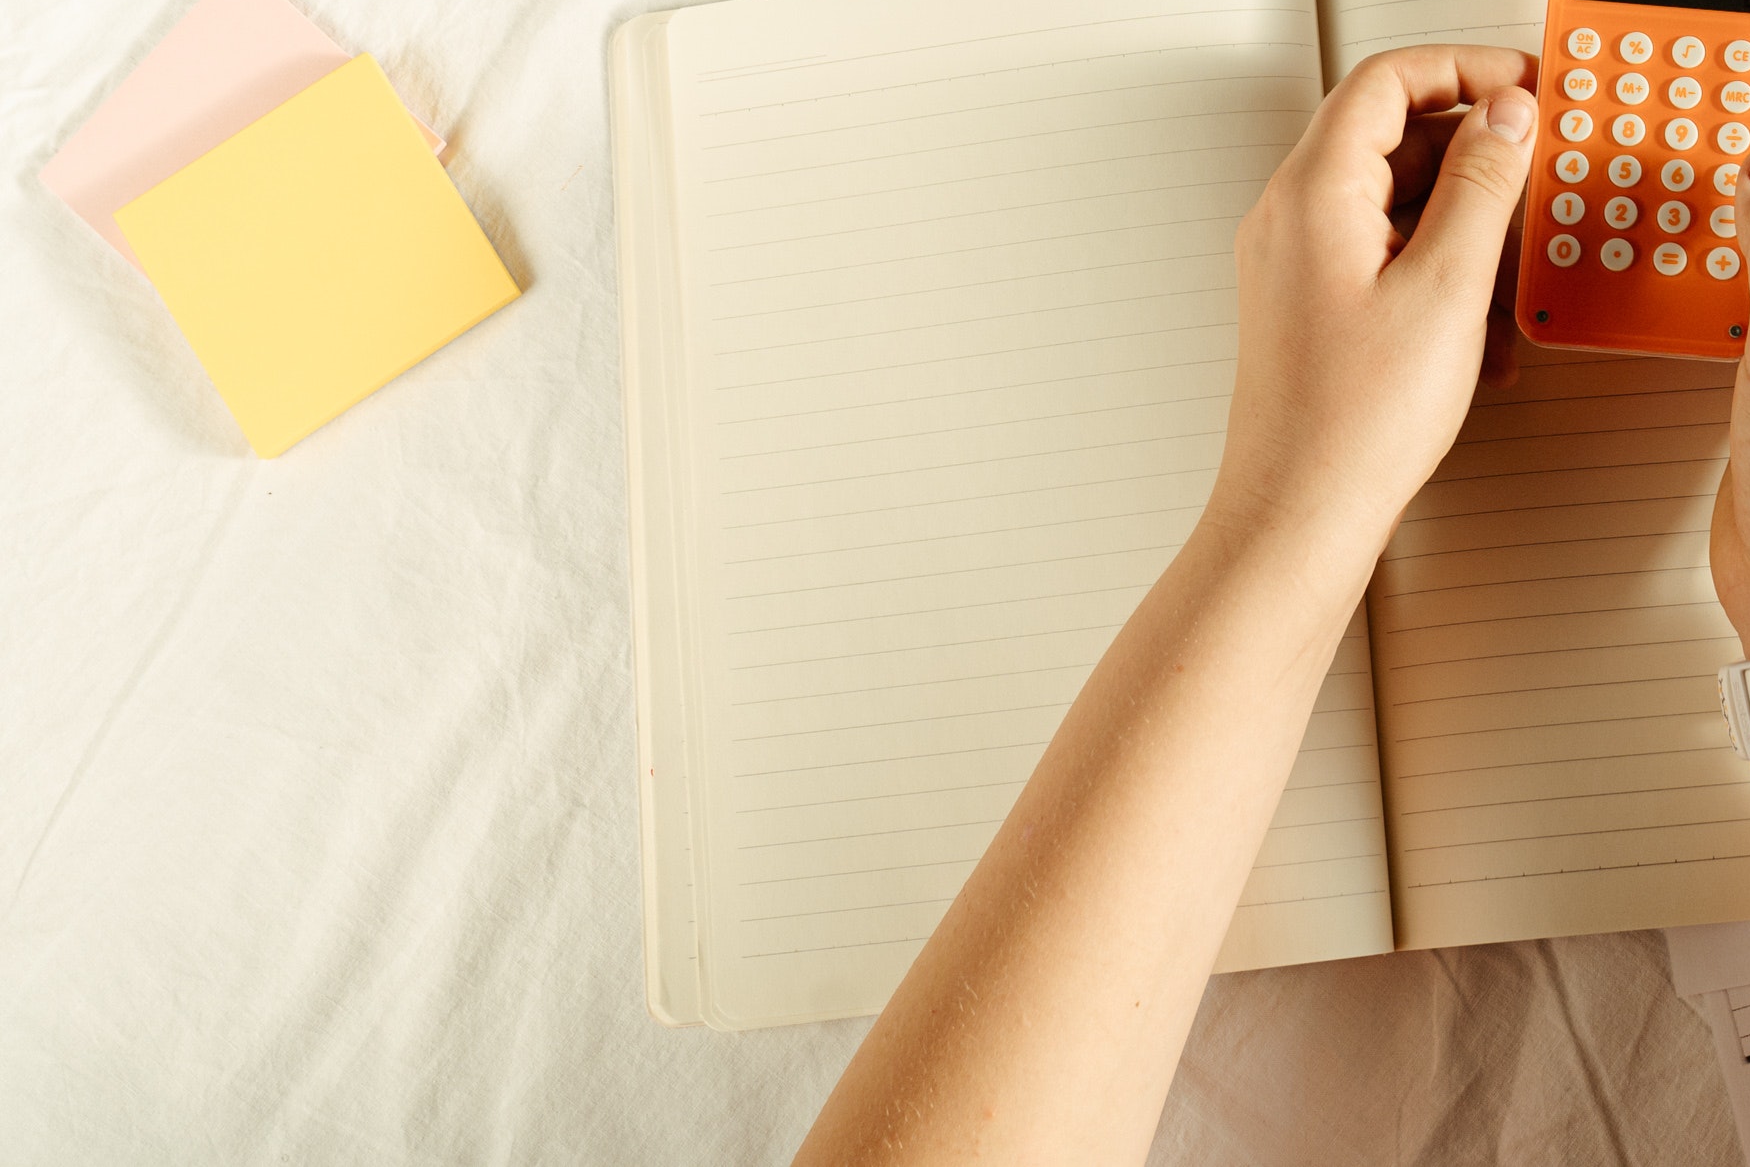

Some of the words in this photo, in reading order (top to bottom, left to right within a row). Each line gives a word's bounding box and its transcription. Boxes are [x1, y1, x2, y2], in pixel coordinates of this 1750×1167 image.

[1577, 33, 1594, 41] ON
[1577, 45, 1591, 54] AC
[1629, 41, 1644, 54] %
[1733, 50, 1749, 62] CE
[1568, 78, 1593, 90] OFF
[1622, 83, 1643, 94] M+
[1675, 87, 1696, 98] M-
[1726, 91, 1749, 103] MRC
[1572, 116, 1583, 134] 7
[1622, 121, 1635, 139] 8
[1676, 125, 1688, 142] 9
[1564, 158, 1580, 176] 4
[1618, 162, 1632, 180] 5
[1671, 166, 1685, 185] 6
[1565, 199, 1573, 217] 1
[1615, 204, 1628, 222] 2
[1668, 208, 1681, 226] 3
[1557, 242, 1571, 259] 0
